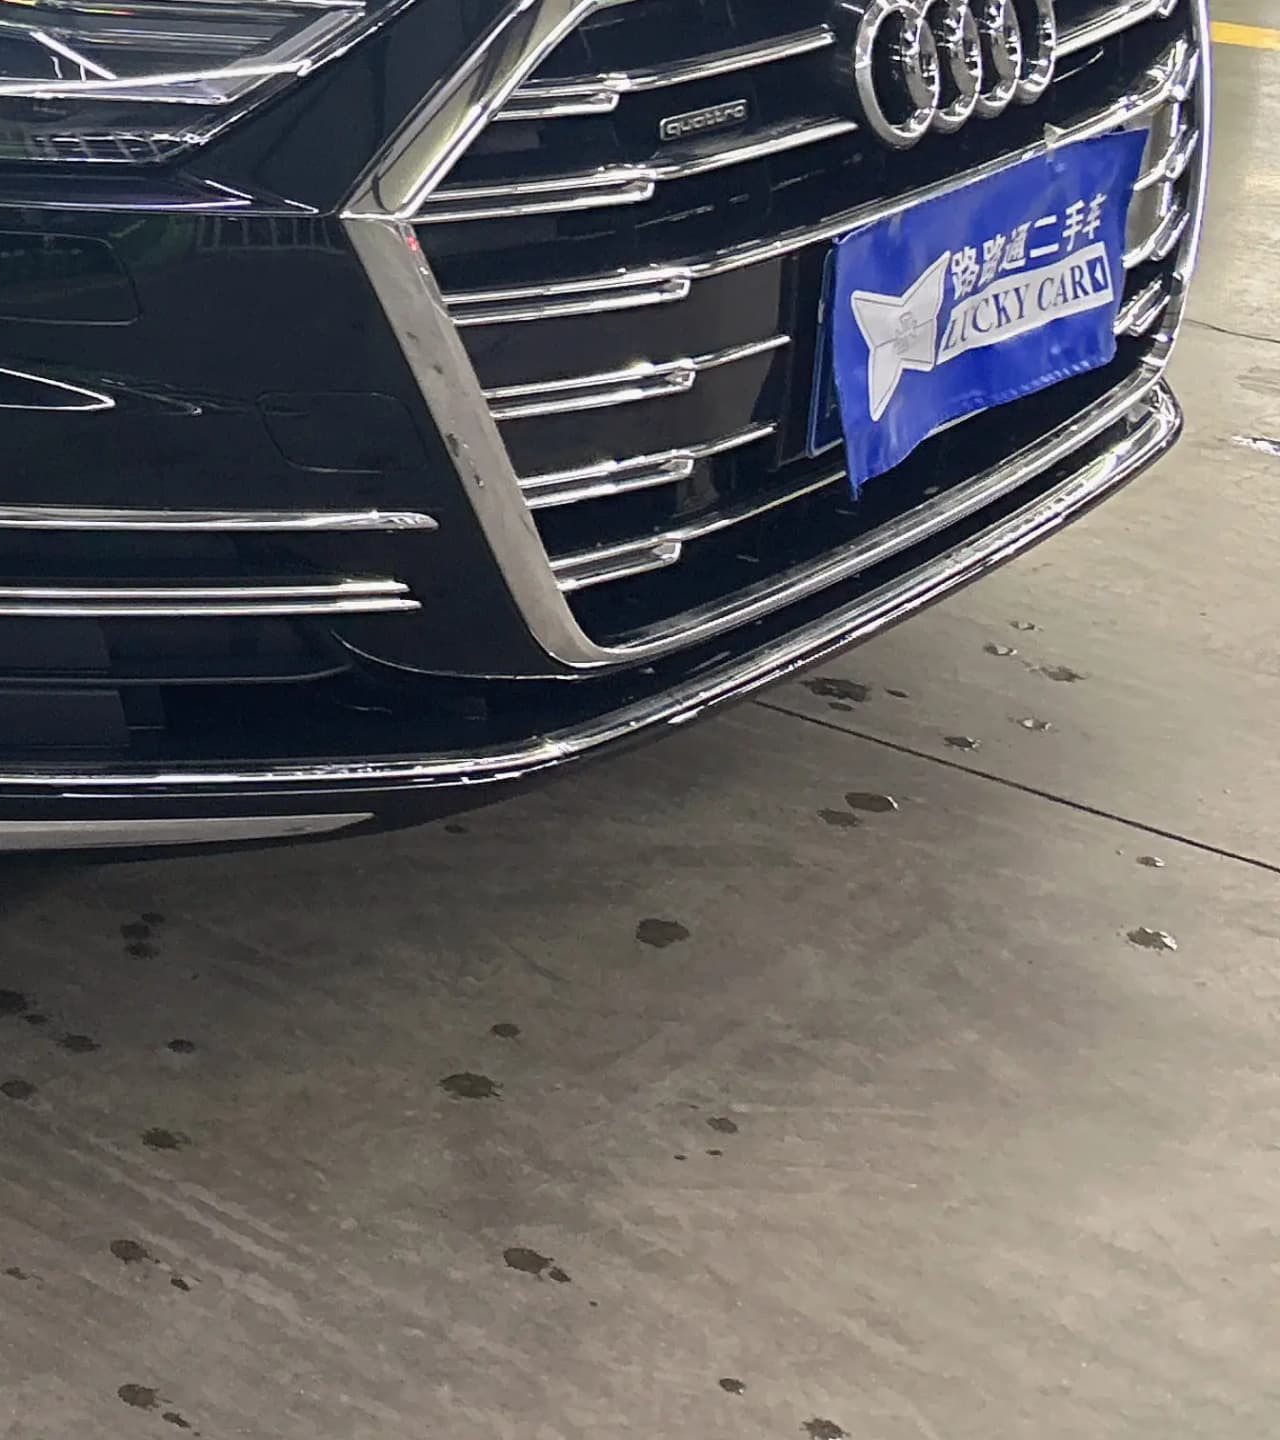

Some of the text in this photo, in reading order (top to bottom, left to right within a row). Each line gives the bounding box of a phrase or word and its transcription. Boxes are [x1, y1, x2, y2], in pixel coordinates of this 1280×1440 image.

[666, 105, 745, 136] quattro
[951, 192, 1108, 300] 路路通二手车
[943, 266, 1092, 351] LUCKY CAR
